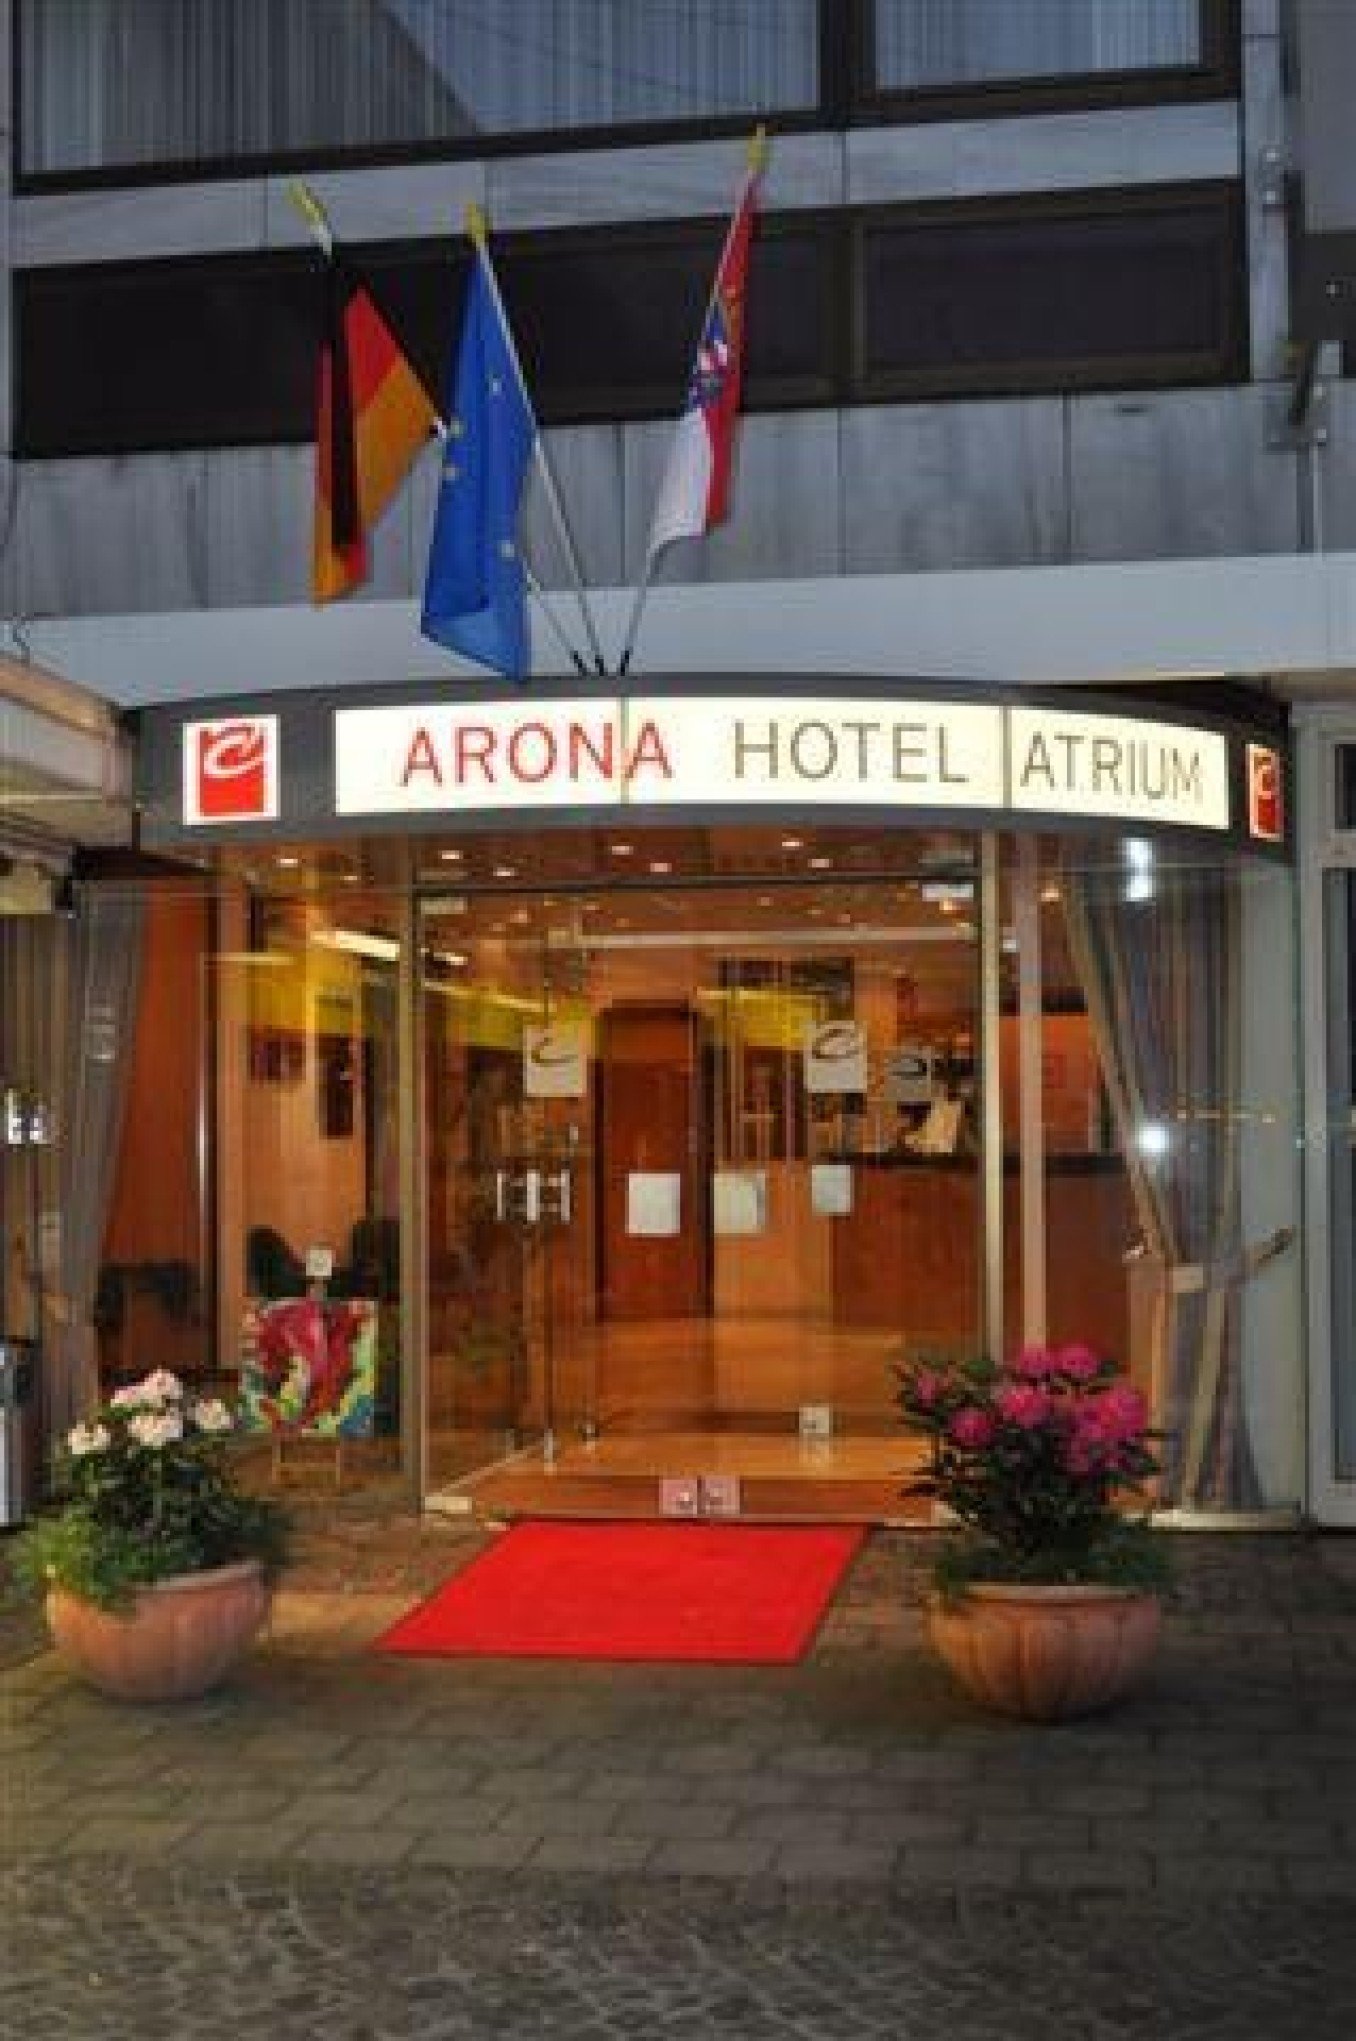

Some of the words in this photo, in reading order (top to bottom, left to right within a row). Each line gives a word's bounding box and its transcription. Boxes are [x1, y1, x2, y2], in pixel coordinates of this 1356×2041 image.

[401, 720, 673, 787] ARONA
[734, 719, 968, 783] HOTEL
[1020, 730, 1203, 803] ATRIUM
